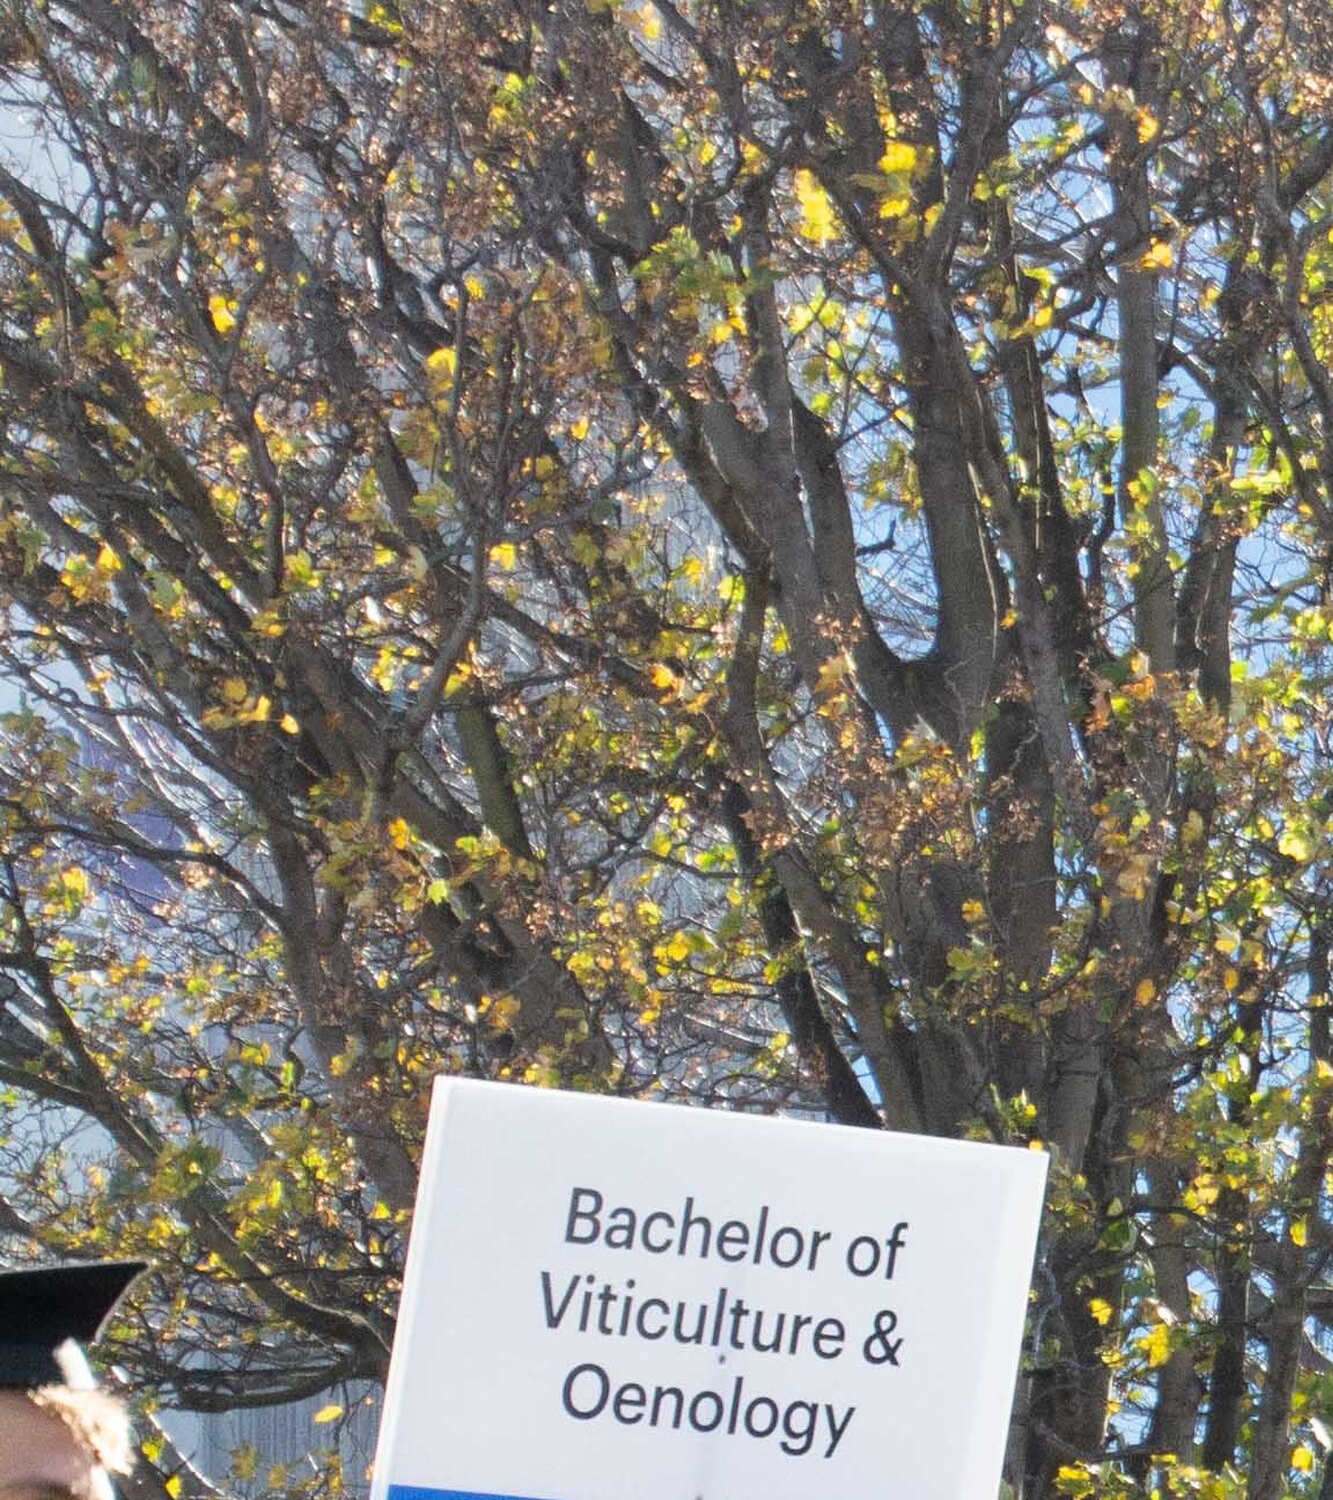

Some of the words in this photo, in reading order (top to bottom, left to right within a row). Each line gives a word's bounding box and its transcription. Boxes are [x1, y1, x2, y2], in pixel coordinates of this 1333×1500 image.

[564, 1186, 833, 1272] Bachelor
[845, 1221, 910, 1281] of
[540, 1270, 846, 1361] Viticulture
[862, 1308, 904, 1368] &
[561, 1362, 857, 1460] Oenology
